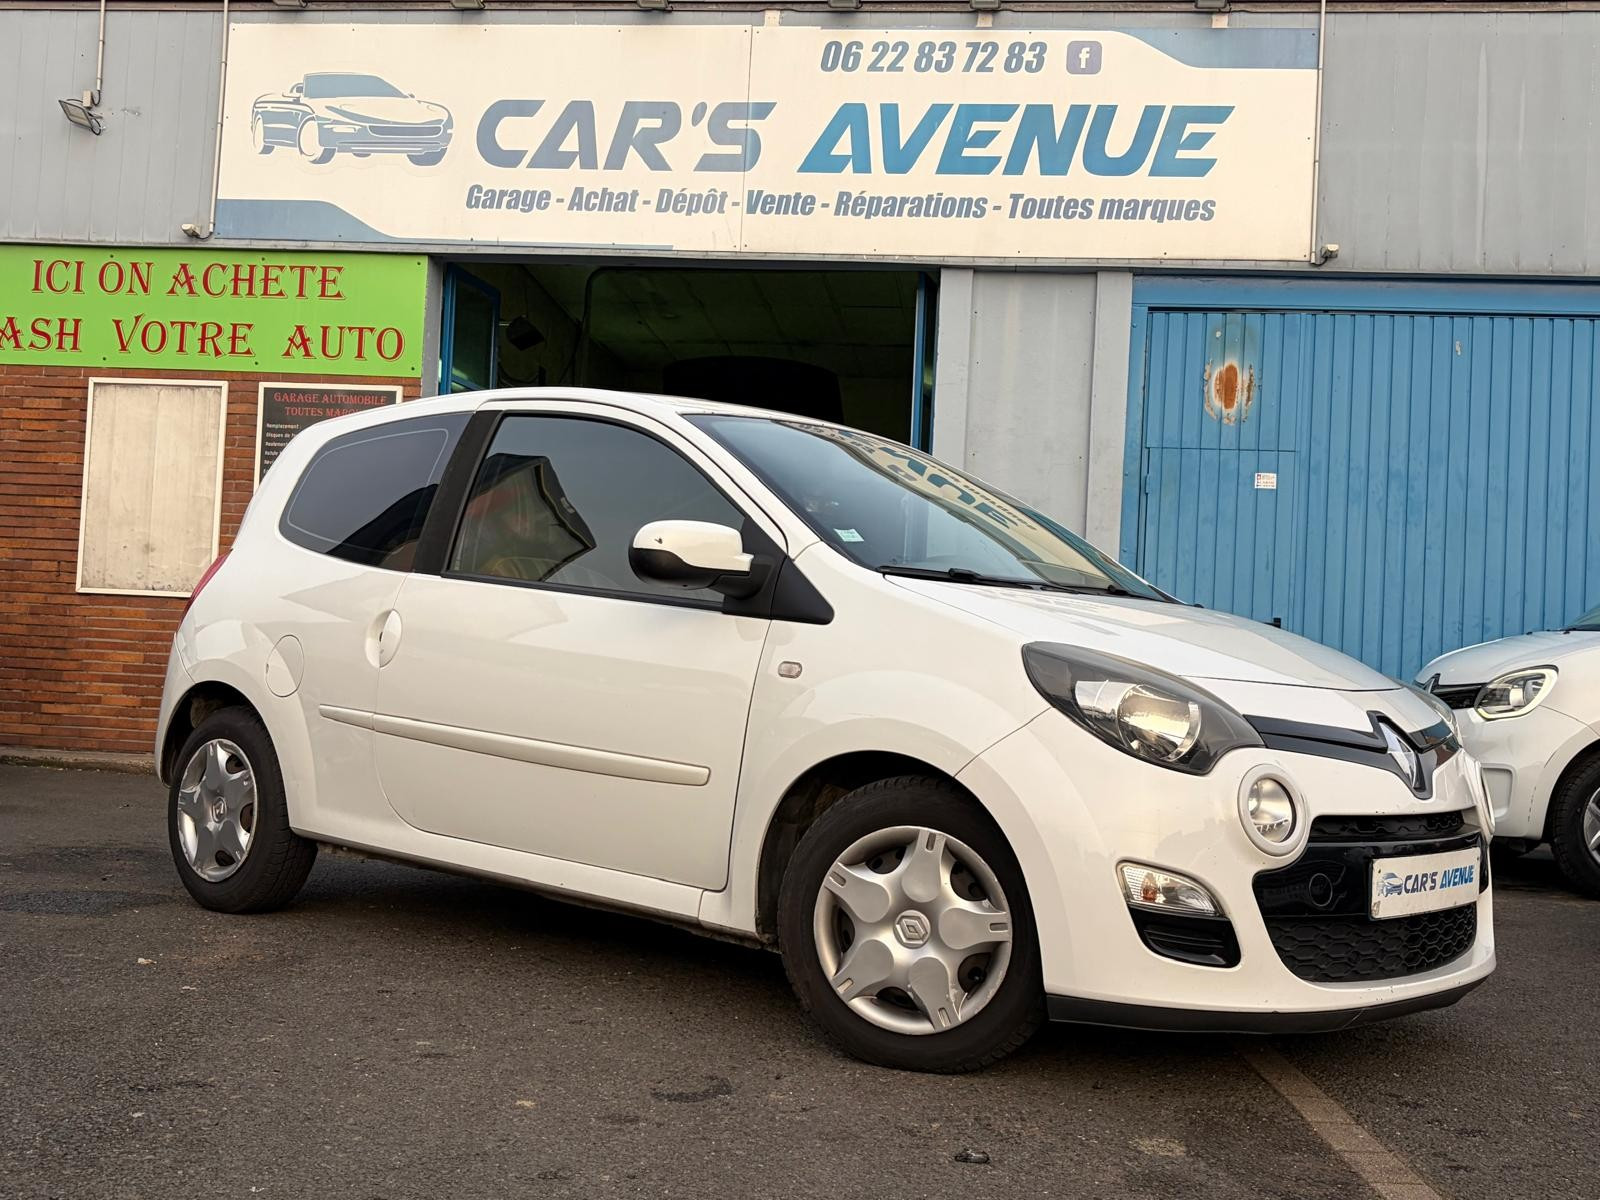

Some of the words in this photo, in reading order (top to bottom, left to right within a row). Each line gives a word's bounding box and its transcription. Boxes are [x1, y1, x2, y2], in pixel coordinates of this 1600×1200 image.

[820, 41, 863, 73] 06
[867, 41, 910, 73] 22
[914, 41, 957, 73] 83
[962, 41, 1000, 73] 72
[1003, 41, 1048, 73] 83
[476, 99, 778, 173] CAR'S
[797, 102, 1236, 178] AVENUE
[466, 184, 552, 213] Garage
[568, 186, 639, 213] Achat
[655, 187, 728, 216] Dépôt
[746, 189, 817, 216] Vente
[834, 190, 988, 220] Réparations
[1008, 193, 1096, 220] Toutes
[1098, 198, 1217, 223] marques
[31, 259, 85, 295] ICI
[98, 260, 153, 296] ON
[166, 262, 346, 300] ACHETE
[112, 313, 256, 359] VOTRE
[281, 324, 406, 361] AUTO
[273, 392, 319, 404] GARAGE
[321, 393, 388, 405] AUTOMOBILE
[284, 406, 324, 417] TOUTES
[1403, 871, 1439, 894] CAR'S
[1439, 864, 1475, 890] AVENUE
